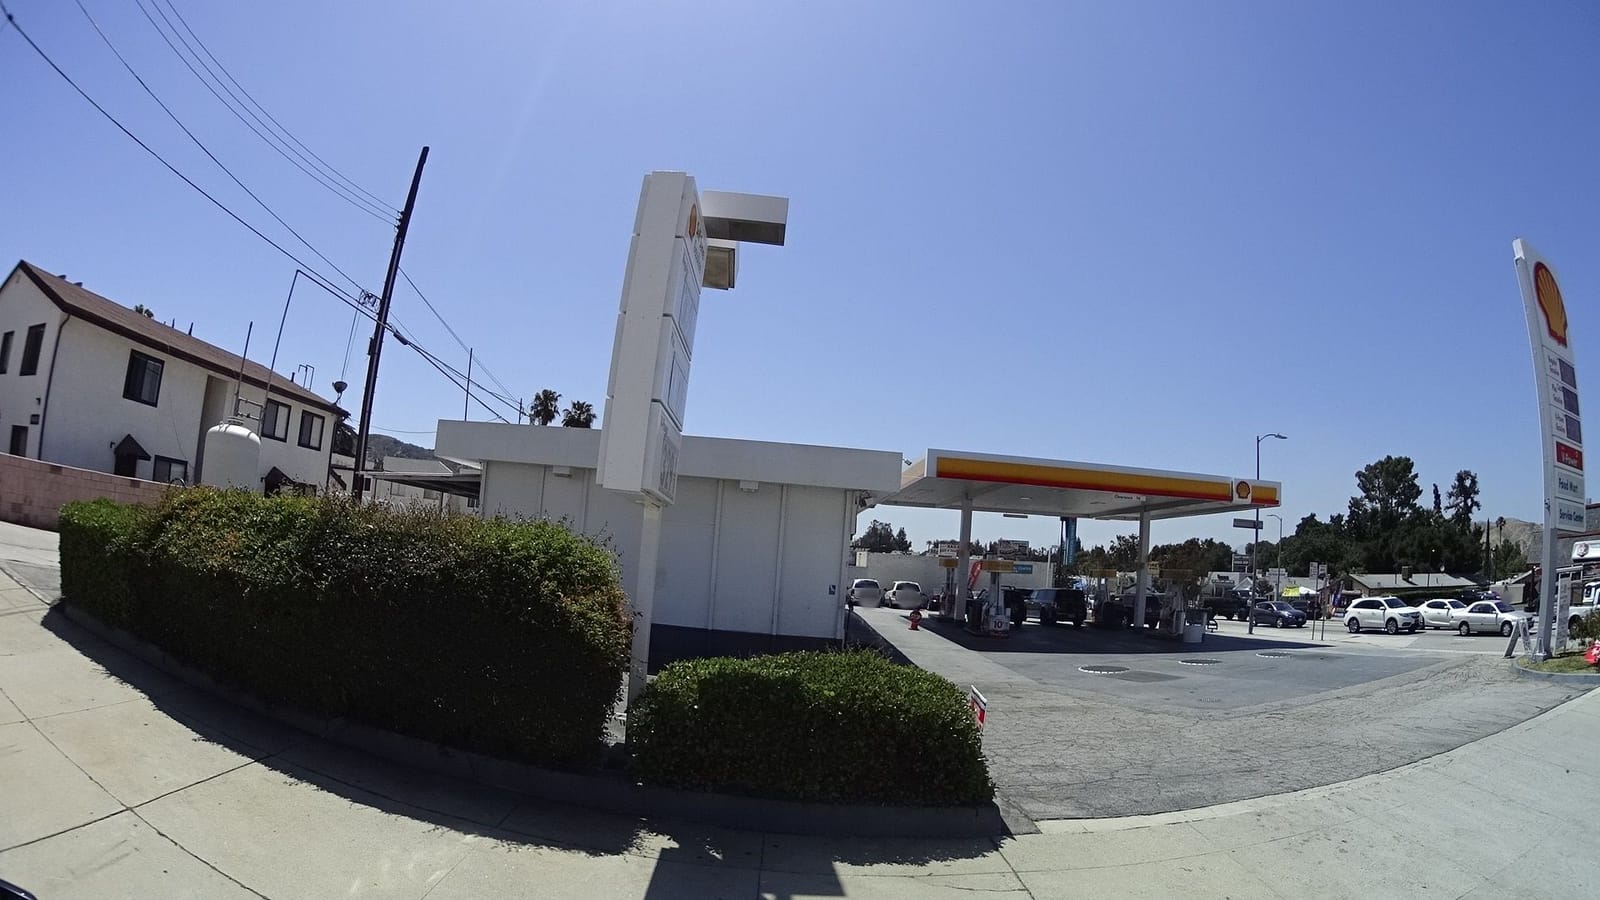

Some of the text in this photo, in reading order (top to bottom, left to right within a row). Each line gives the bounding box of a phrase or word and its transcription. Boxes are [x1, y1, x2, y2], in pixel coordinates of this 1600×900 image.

[1559, 478, 1569, 491] Food
[1560, 509, 1583, 522] Service Center
